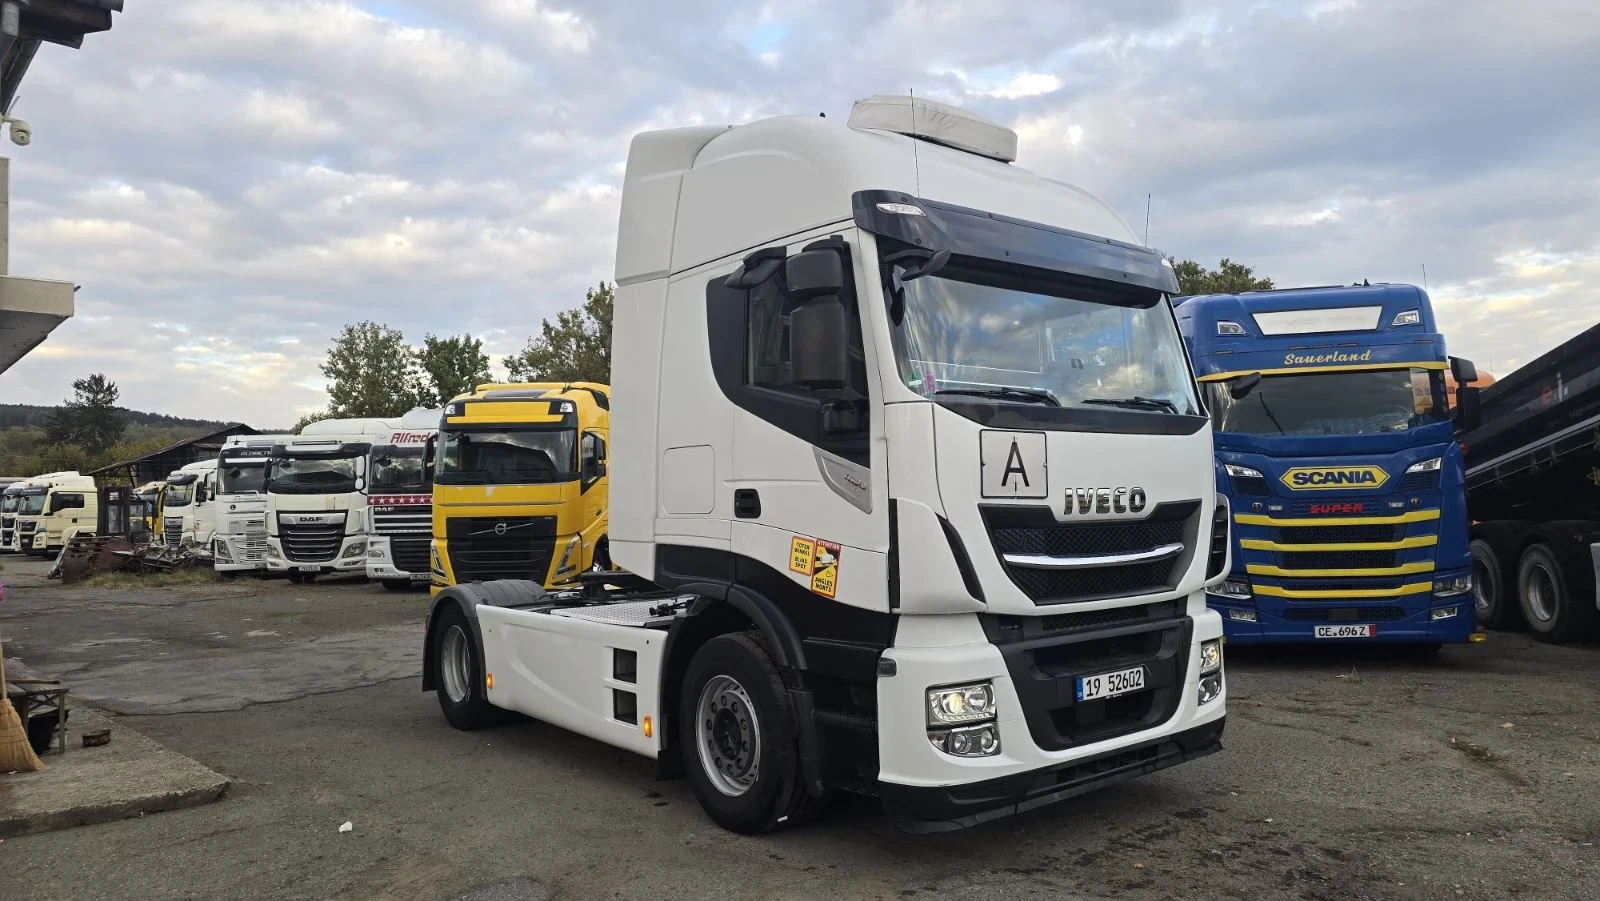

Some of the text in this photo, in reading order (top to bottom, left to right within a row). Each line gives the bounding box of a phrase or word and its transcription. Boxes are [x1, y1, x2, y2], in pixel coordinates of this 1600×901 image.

[1283, 349, 1372, 365] Sauerland
[1000, 440, 1030, 487] A
[1292, 470, 1377, 485] SCANIA
[1063, 486, 1147, 516] IVECO
[1309, 502, 1364, 514] SUPER
[815, 577, 833, 587] ANGLES
[815, 583, 832, 592] MORTS
[1086, 670, 1142, 697] 19 52602
